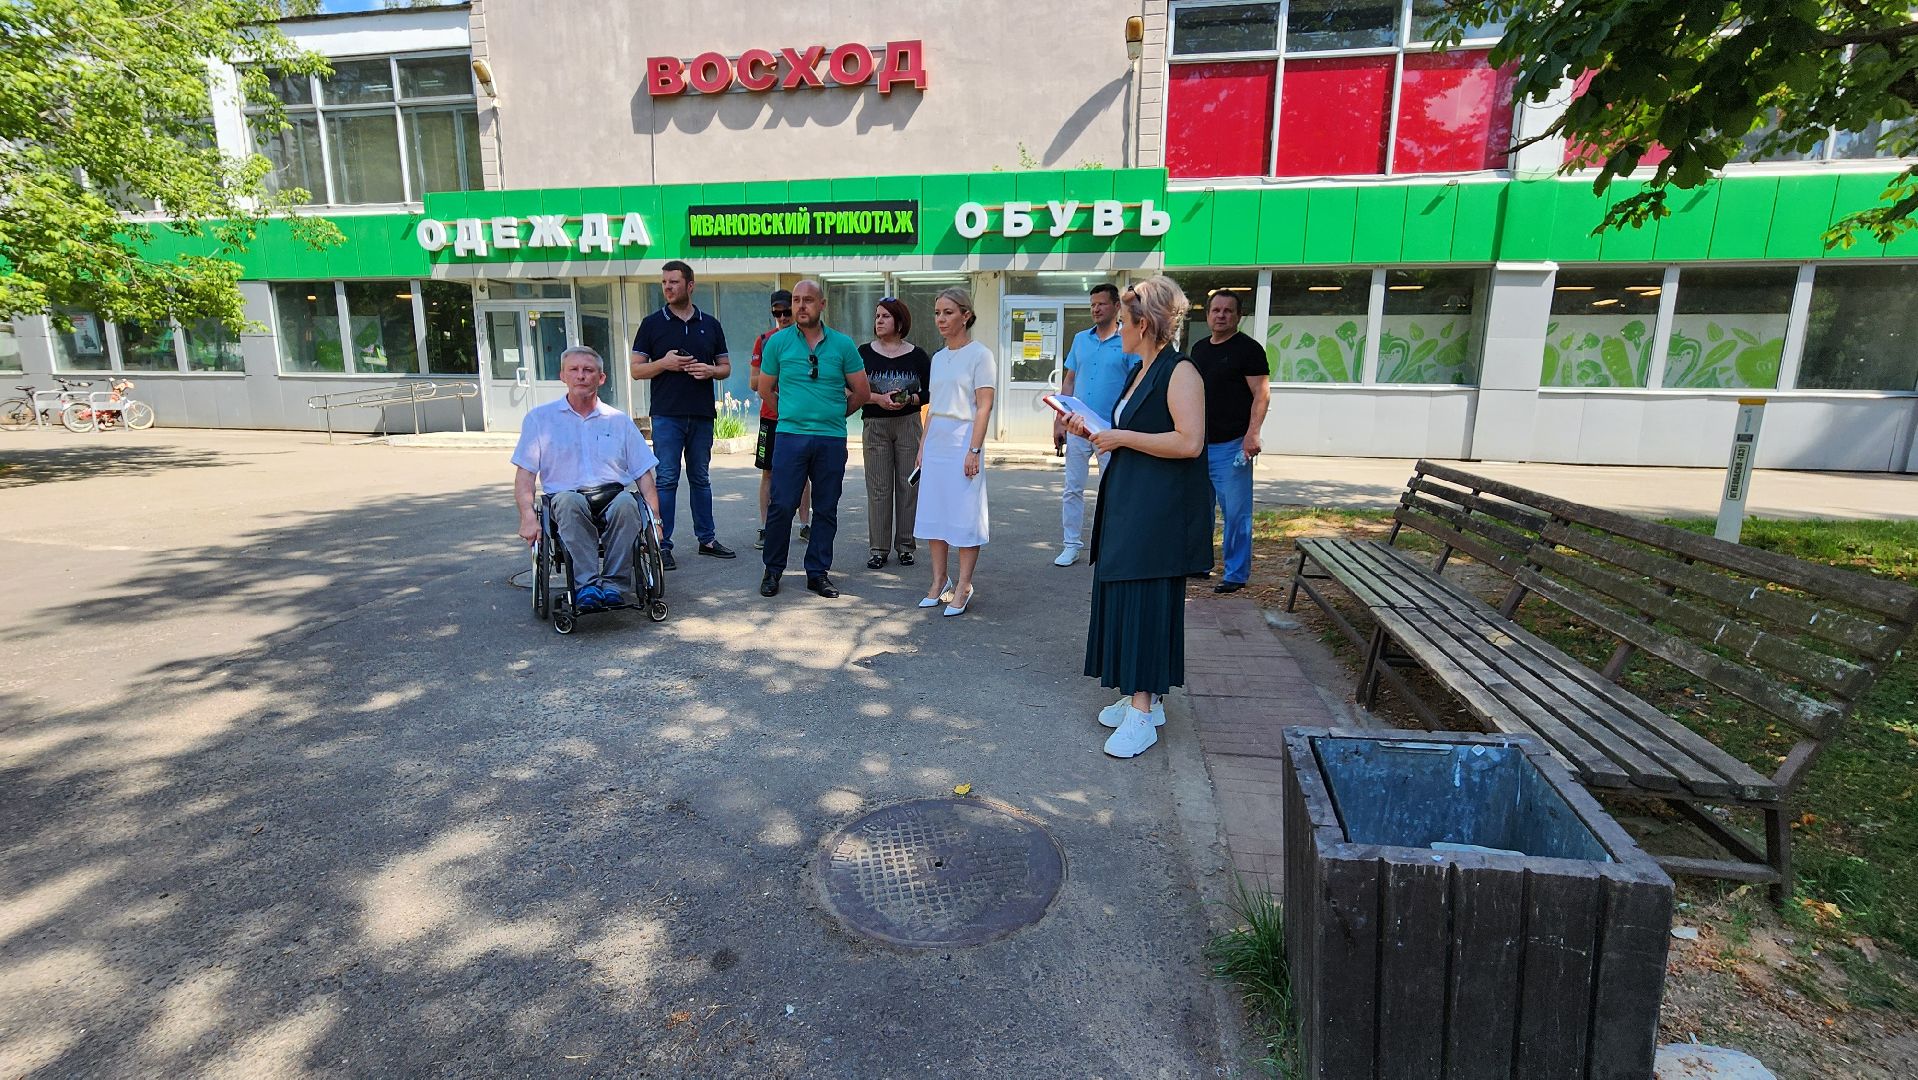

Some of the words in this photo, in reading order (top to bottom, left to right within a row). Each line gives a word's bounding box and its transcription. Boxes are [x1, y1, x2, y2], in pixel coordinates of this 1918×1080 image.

[647, 40, 928, 95] ВОСХОД
[417, 212, 650, 257] ОДЕЖДА
[690, 207, 810, 236] ИВАНОВСКИЙ
[813, 210, 914, 235] ТРИКОТАЖ
[955, 199, 1171, 239] ОБУВЬ
